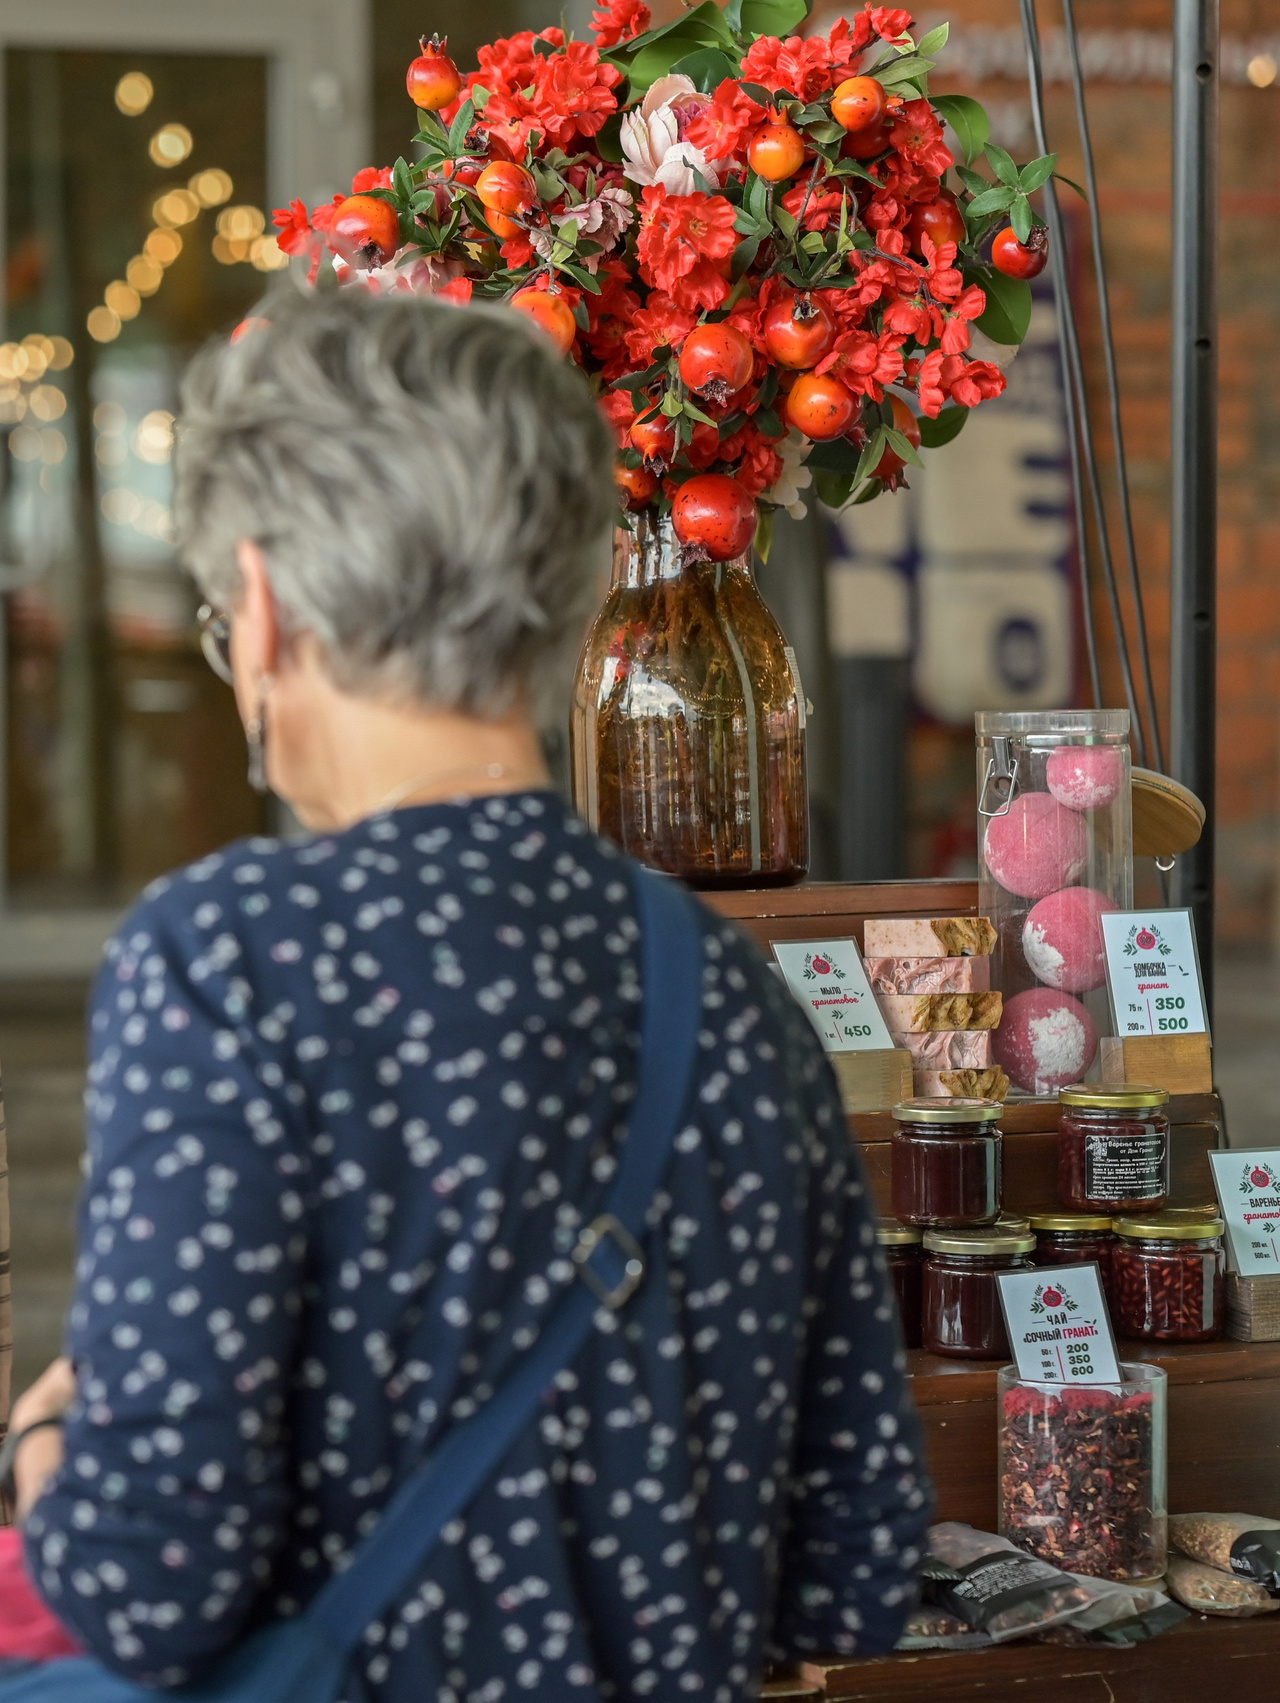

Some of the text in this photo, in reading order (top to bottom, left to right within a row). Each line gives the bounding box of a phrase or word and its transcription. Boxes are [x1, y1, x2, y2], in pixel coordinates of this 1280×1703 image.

[1134, 962, 1166, 971] БОМБОЧКА
[820, 986, 841, 995] МЫЛО
[1137, 982, 1170, 994] гранат
[811, 994, 859, 1010] гранатовое
[1155, 997, 1185, 1010] 350
[1128, 1004, 1137, 1012] 75
[1127, 1022, 1139, 1031] 200
[1158, 1017, 1188, 1031] 500
[844, 1025, 872, 1037] 450
[1243, 1208, 1280, 1225] гранато
[1046, 1312, 1068, 1325] ЧАЙ
[1066, 1343, 1089, 1354] 200
[1068, 1354, 1091, 1365] 350
[1071, 1365, 1094, 1376] 600
